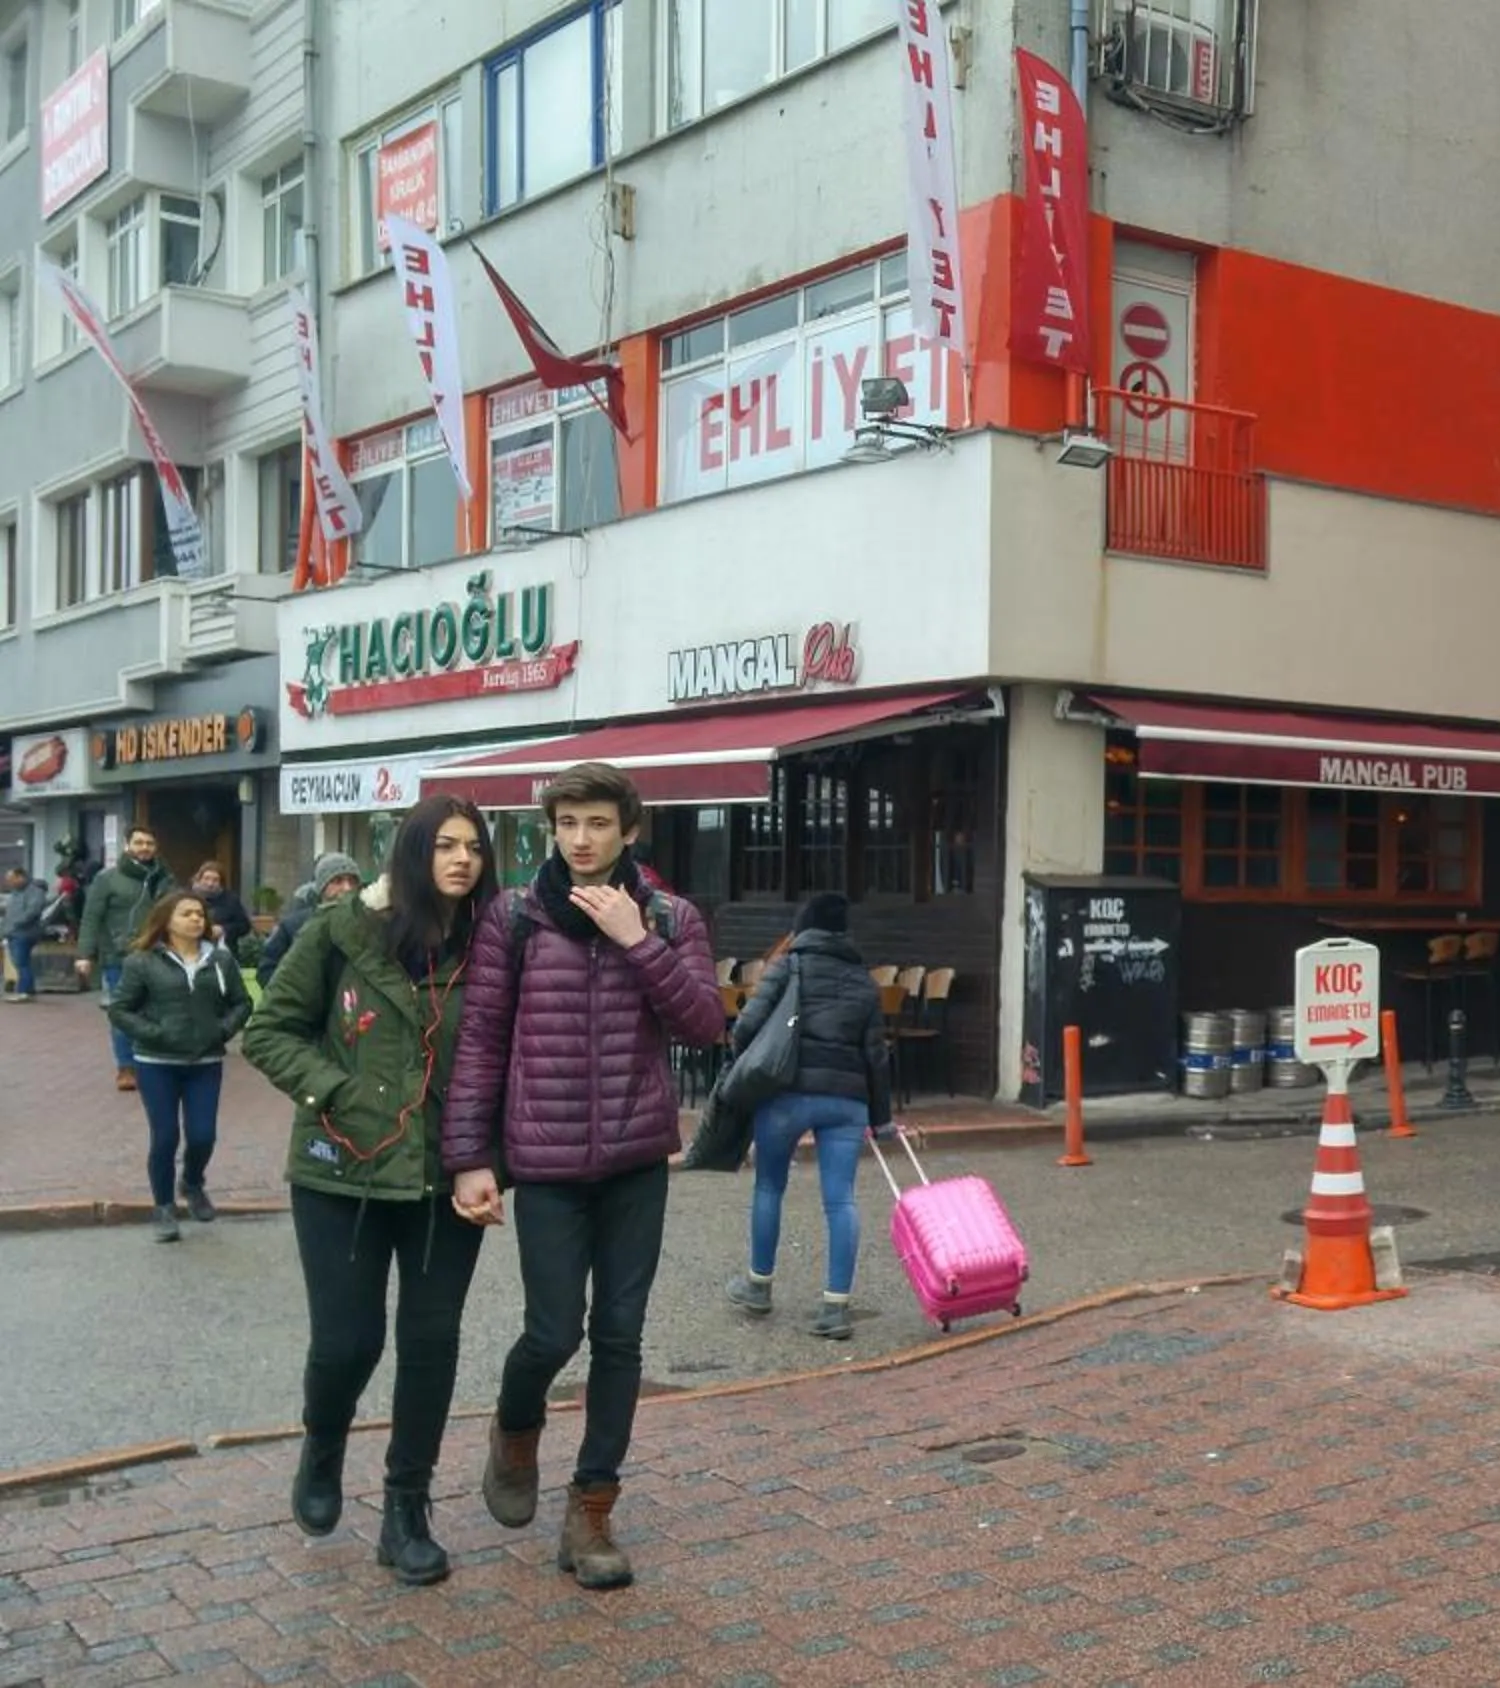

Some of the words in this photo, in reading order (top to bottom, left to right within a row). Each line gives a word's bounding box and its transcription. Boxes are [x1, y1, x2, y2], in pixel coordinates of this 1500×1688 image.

[338, 569, 550, 684] HACIOĞLU
[668, 633, 797, 702] MANGAL
[801, 621, 855, 690] Pub
[1319, 756, 1417, 788] MANGAL
[1422, 763, 1468, 791] PUB
[1089, 897, 1124, 922] KOÇ
[1315, 963, 1363, 997] KOÇ
